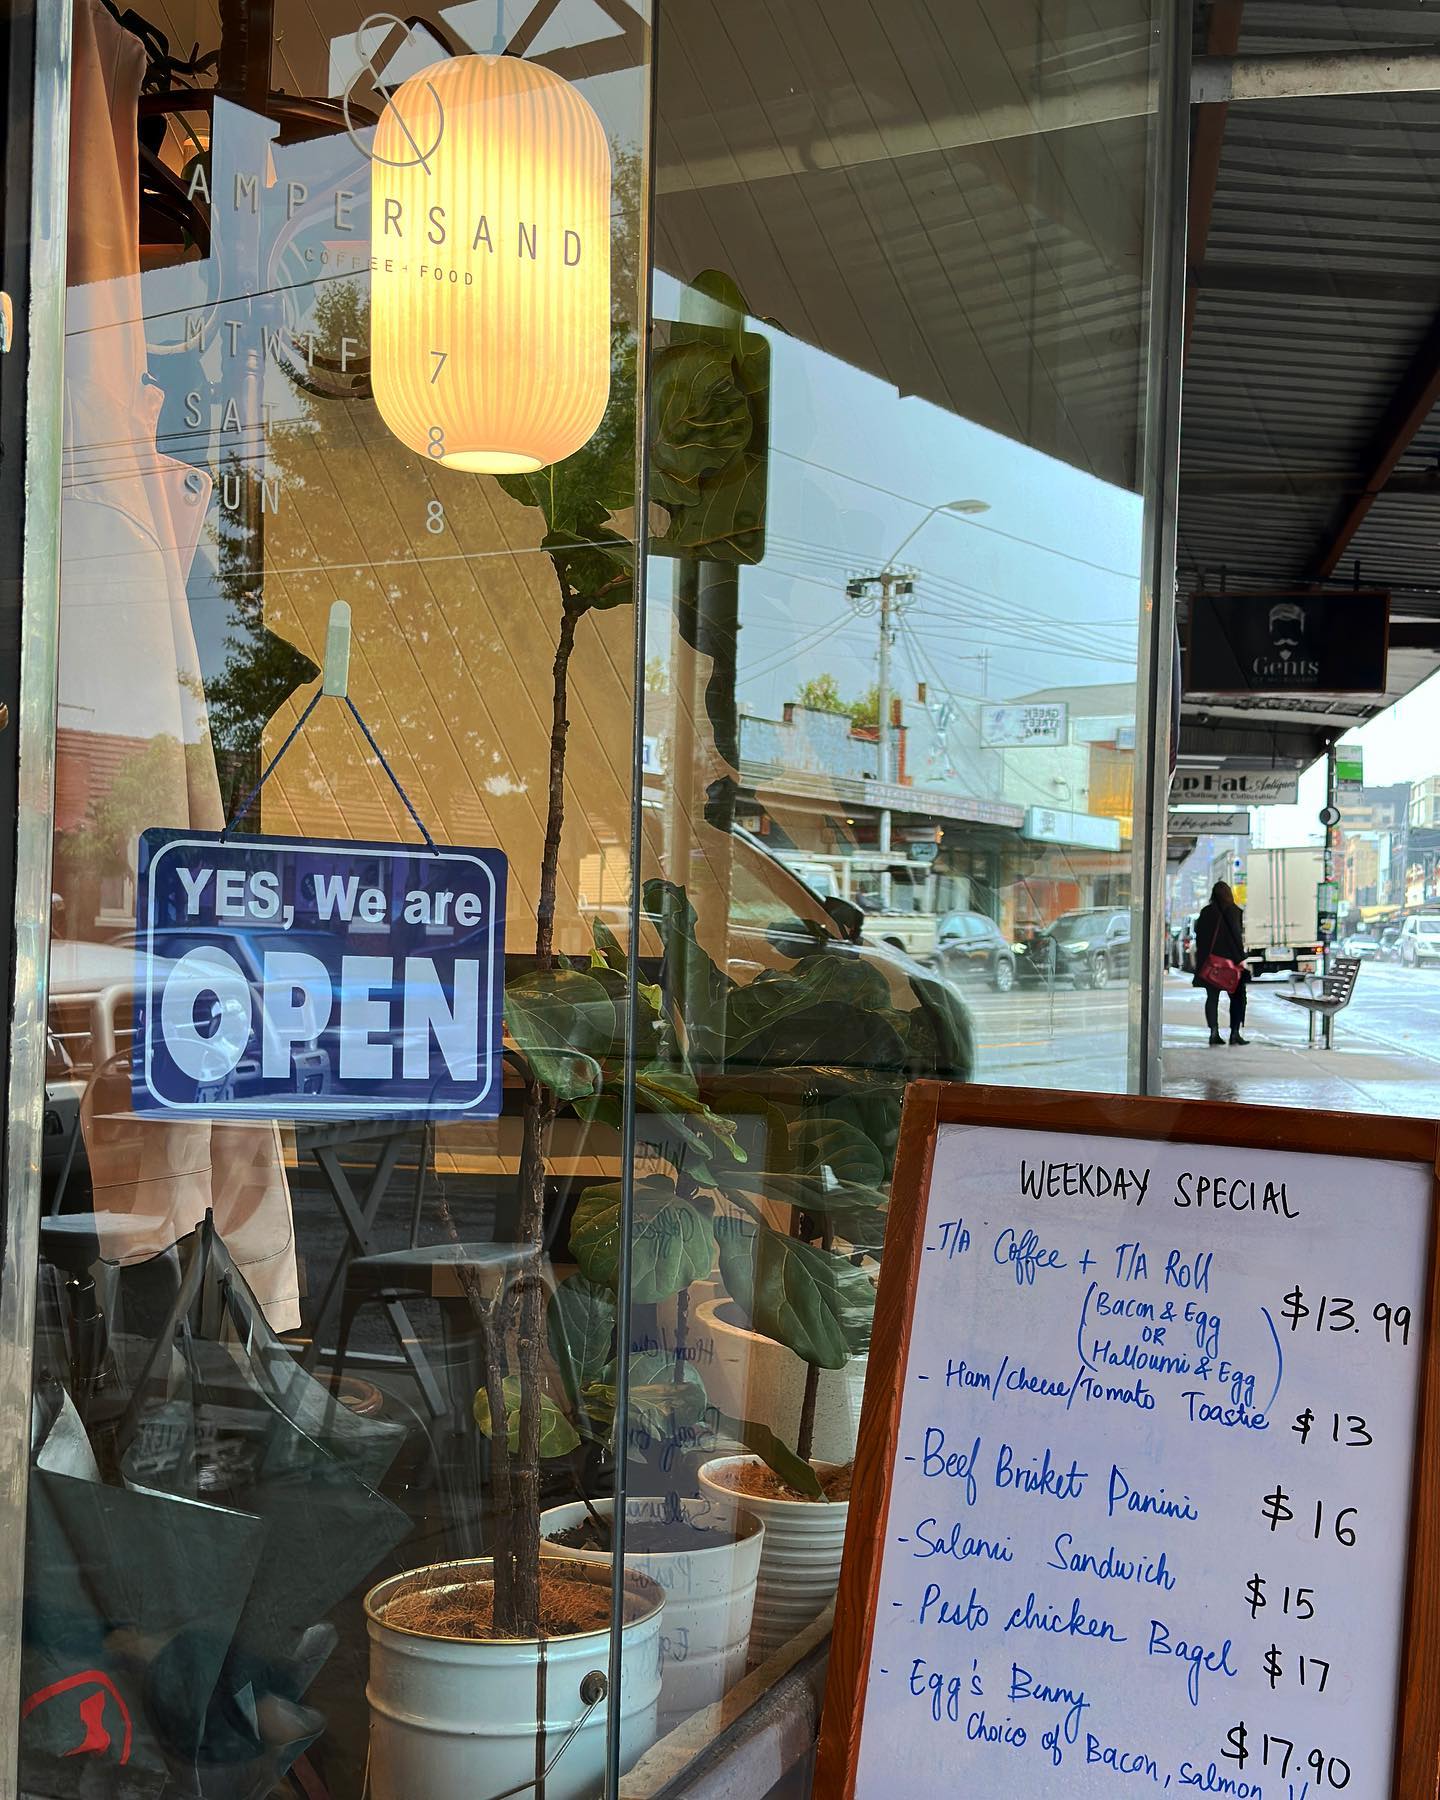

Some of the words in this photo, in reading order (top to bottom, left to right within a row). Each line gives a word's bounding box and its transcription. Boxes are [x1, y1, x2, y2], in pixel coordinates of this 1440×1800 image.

[344, 13, 444, 176] &
[187, 163, 582, 267] AMPERSAND
[304, 248, 394, 272] COFFEE
[420, 264, 474, 286] FOOD
[430, 350, 448, 384] 7
[185, 391, 280, 437] SAT
[427, 426, 445, 459] 8
[184, 473, 280, 515] SUN
[426, 500, 445, 534] 8
[1252, 657, 1319, 675] Gents
[175, 867, 295, 930] YES,
[314, 874, 387, 923] We
[404, 889, 482, 927] are
[161, 945, 480, 1082] OPEN
[1020, 1160, 1151, 1206] WEEKDAY
[1174, 1172, 1300, 1218] SPECIAL
[994, 1228, 1067, 1285] Coffee
[1079, 1248, 1097, 1274] +
[1115, 1242, 1149, 1282] T/A
[1165, 1252, 1214, 1294] Roll
[1142, 1326, 1165, 1346] OR
[1159, 1303, 1178, 1323] &
[1185, 1303, 1221, 1359] Egg
[1092, 1339, 1191, 1375] Halloumi
[1194, 1357, 1213, 1380] &
[1218, 1362, 1257, 1408] Egg
[1181, 1391, 1270, 1431] Toastie
[995, 1452, 1088, 1511] Brisket
[1108, 1465, 1199, 1521] Panini
[1047, 1533, 1177, 1590] Sandwich
[919, 1583, 990, 1629] Pesto
[1149, 1620, 1238, 1706] Bagel
[909, 1658, 985, 1722] Egg's
[1009, 1662, 1091, 1744] Benny
[1041, 1723, 1063, 1766] of
